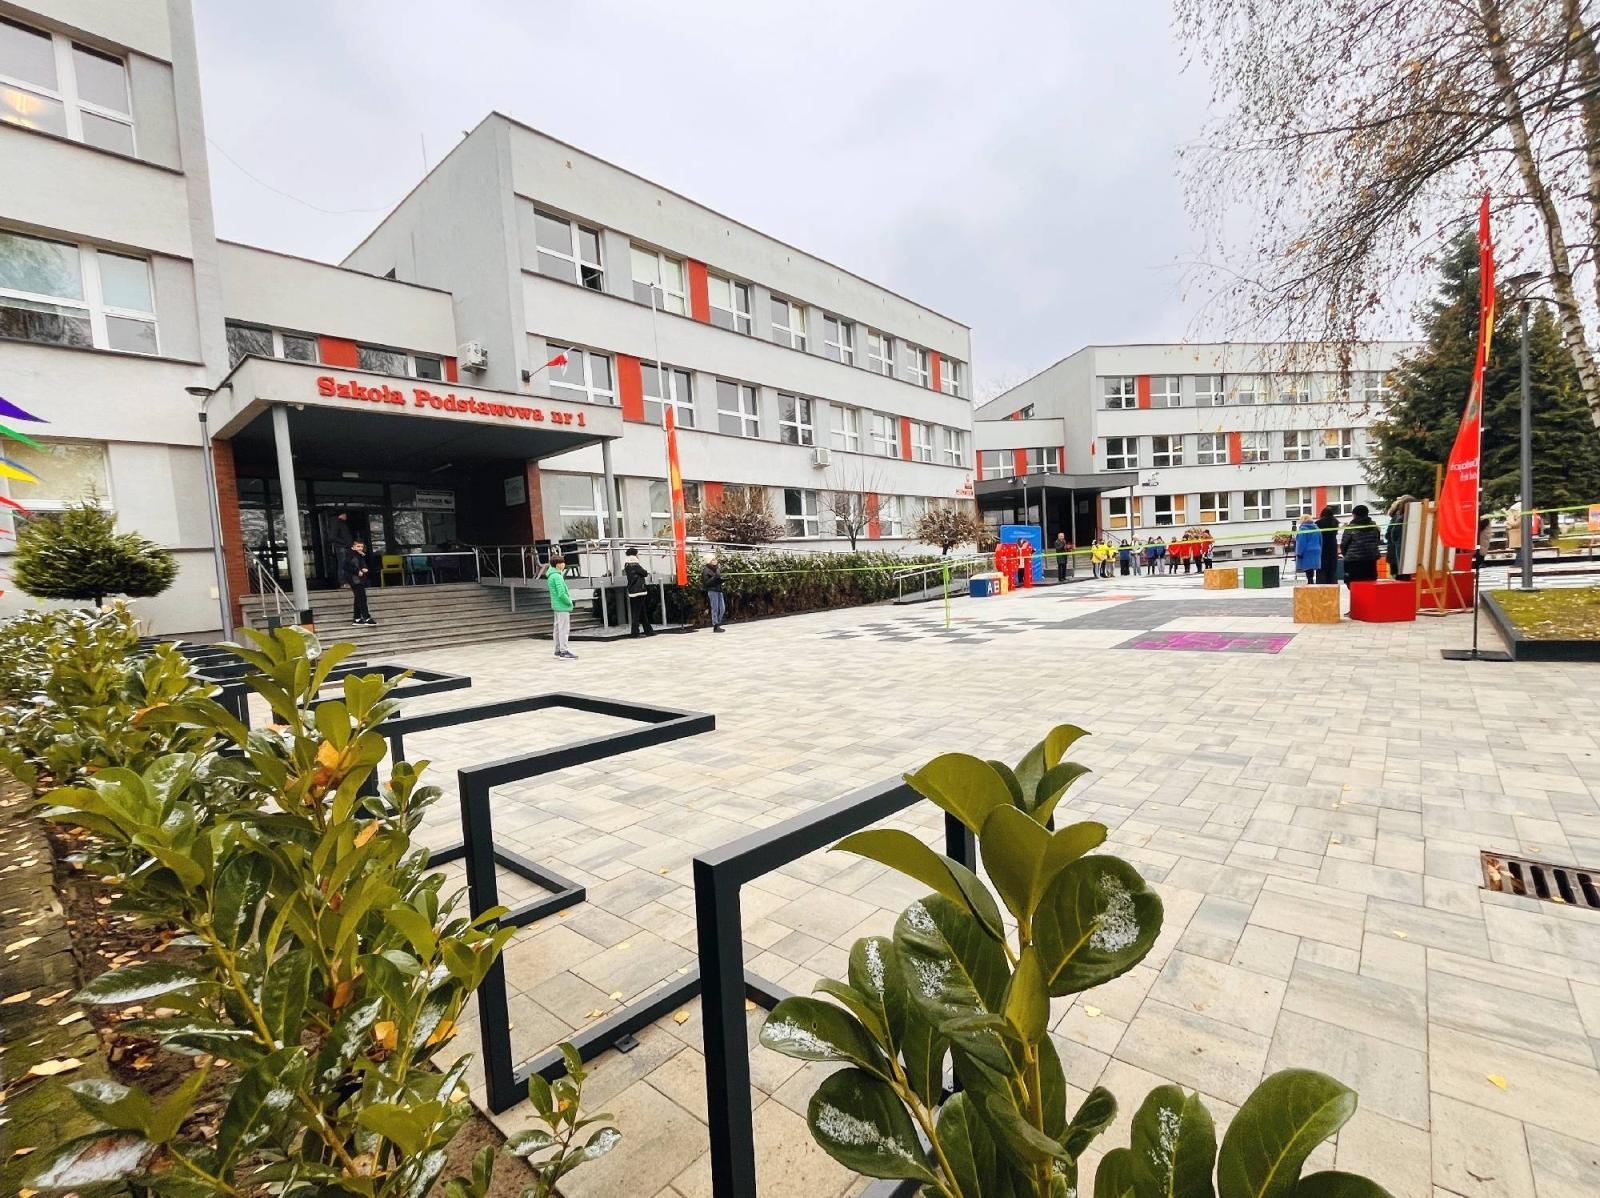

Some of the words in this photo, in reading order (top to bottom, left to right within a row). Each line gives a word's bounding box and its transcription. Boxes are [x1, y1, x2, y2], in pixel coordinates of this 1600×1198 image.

[317, 376, 406, 405] Szkoła
[413, 389, 544, 422] Podstawowa
[551, 410, 573, 425] nr
[577, 411, 586, 427] 1
